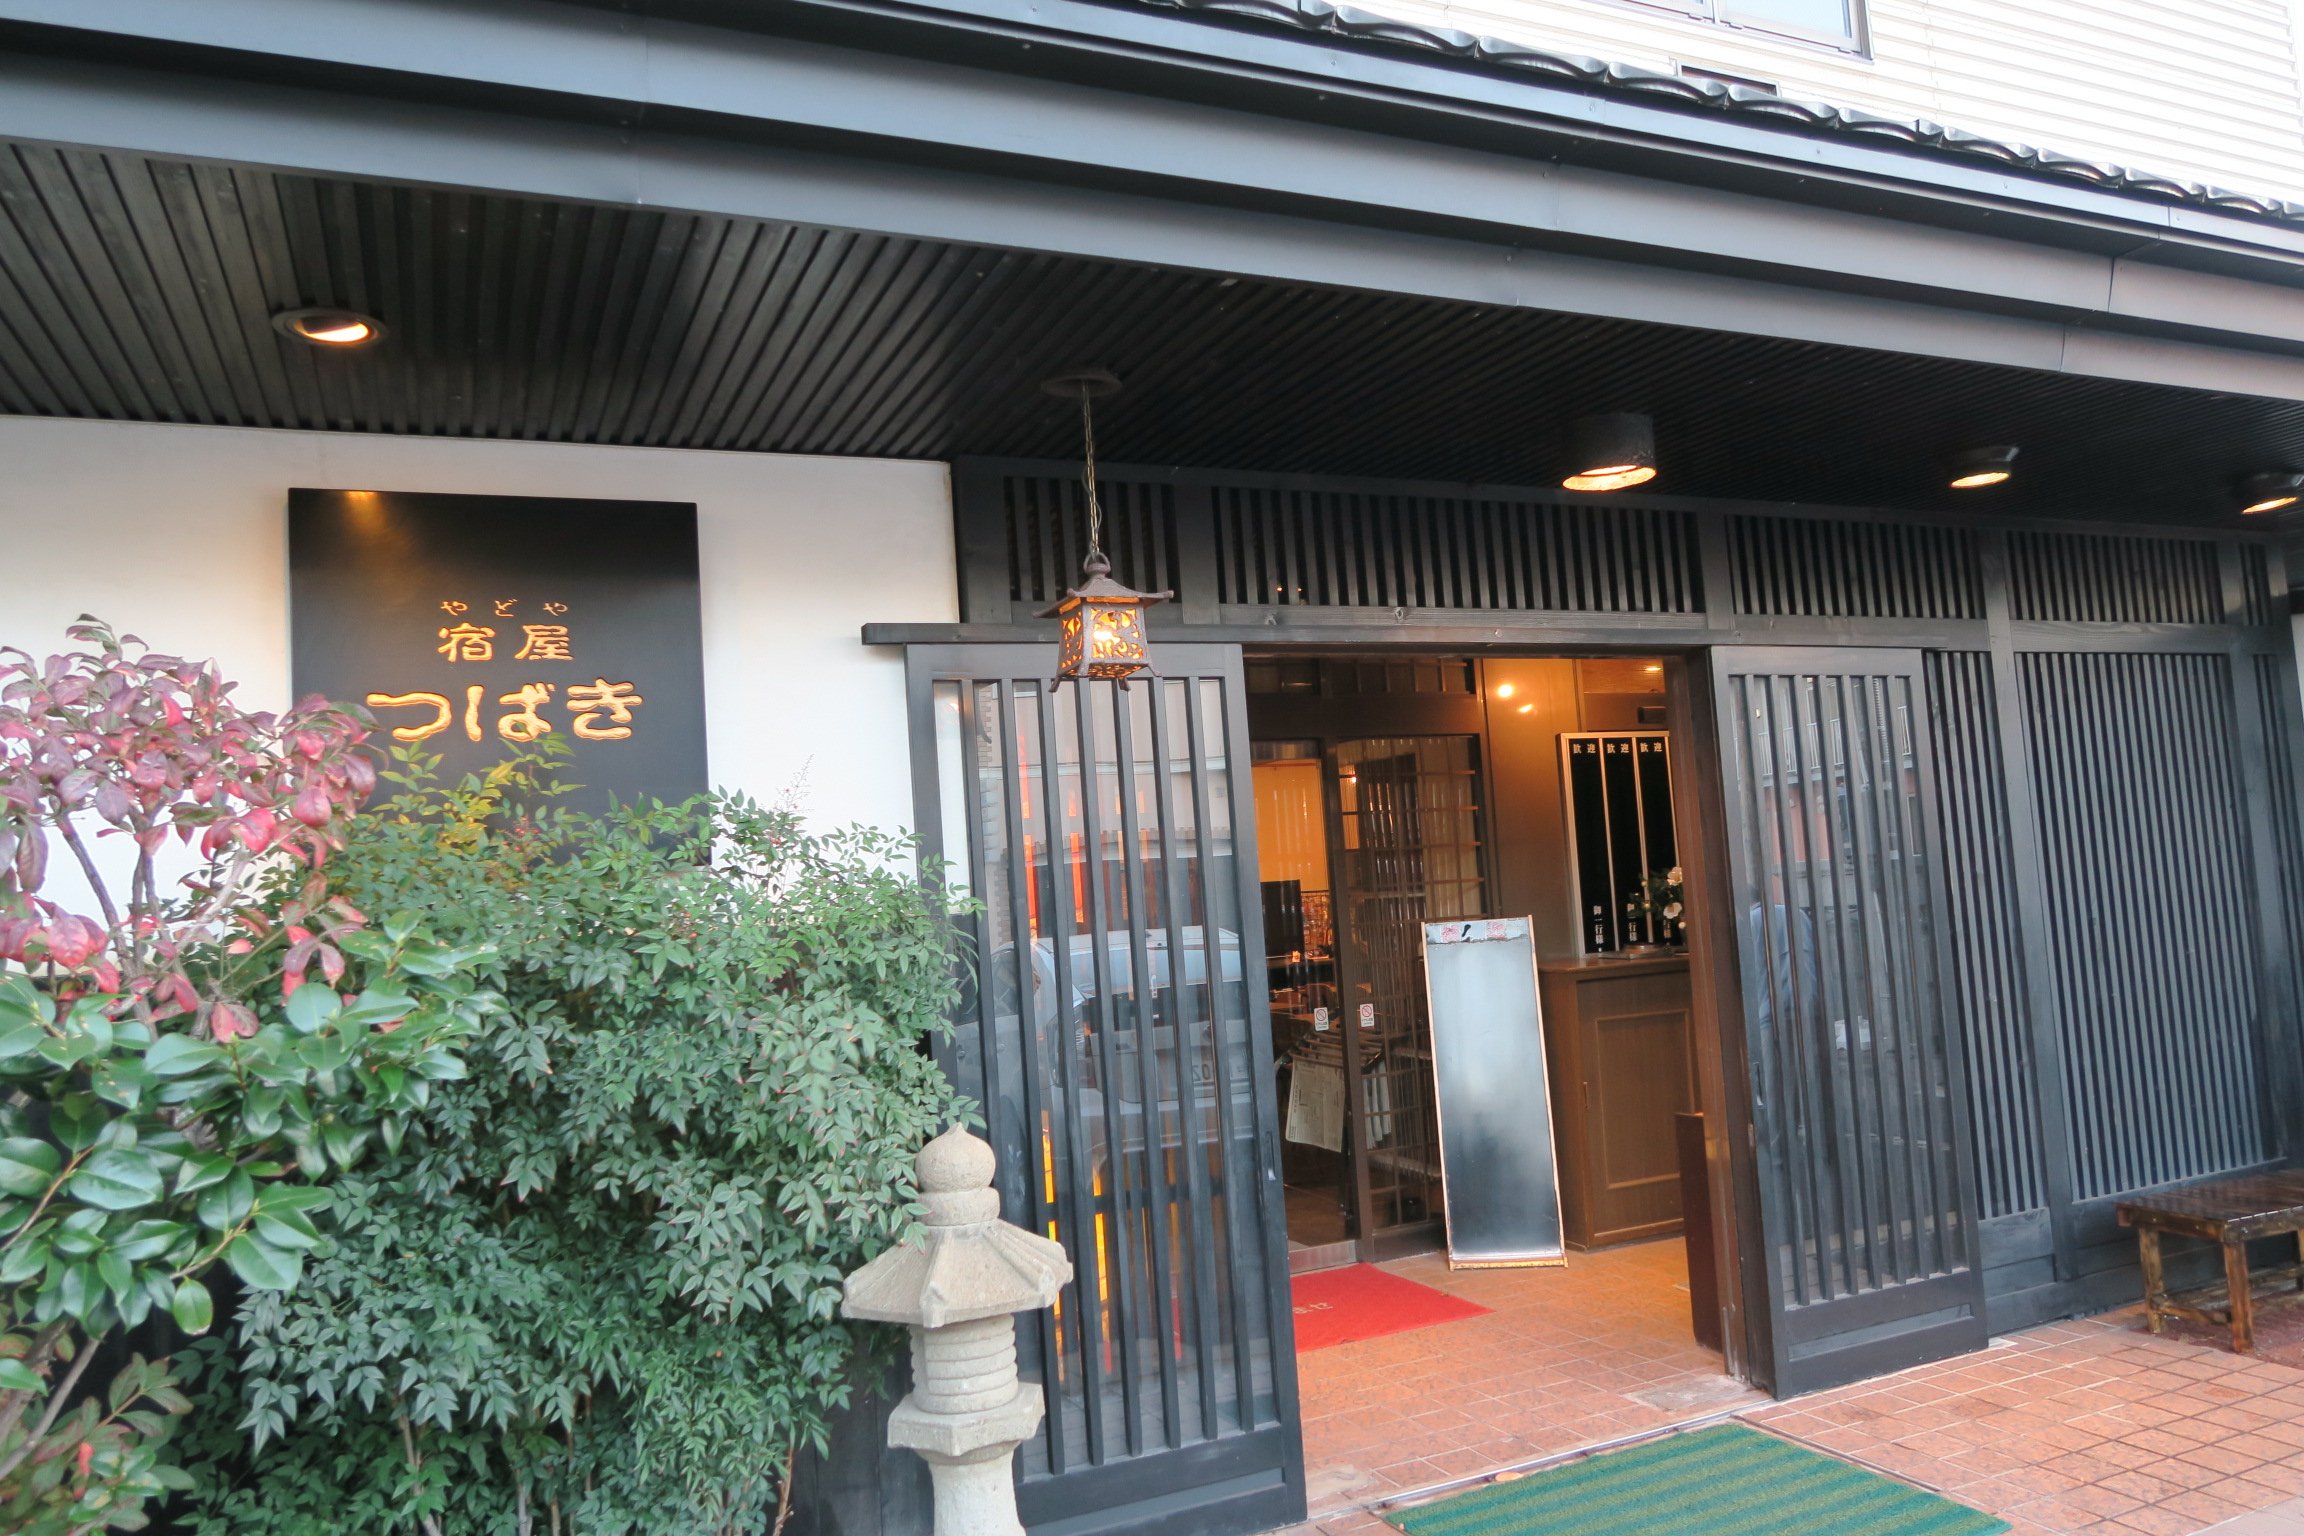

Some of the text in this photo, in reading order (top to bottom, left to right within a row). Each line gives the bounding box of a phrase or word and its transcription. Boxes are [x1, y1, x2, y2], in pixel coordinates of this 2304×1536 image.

[440, 598, 569, 617] やどや
[437, 622, 575, 663] 宿屋
[366, 677, 643, 742] つばき
